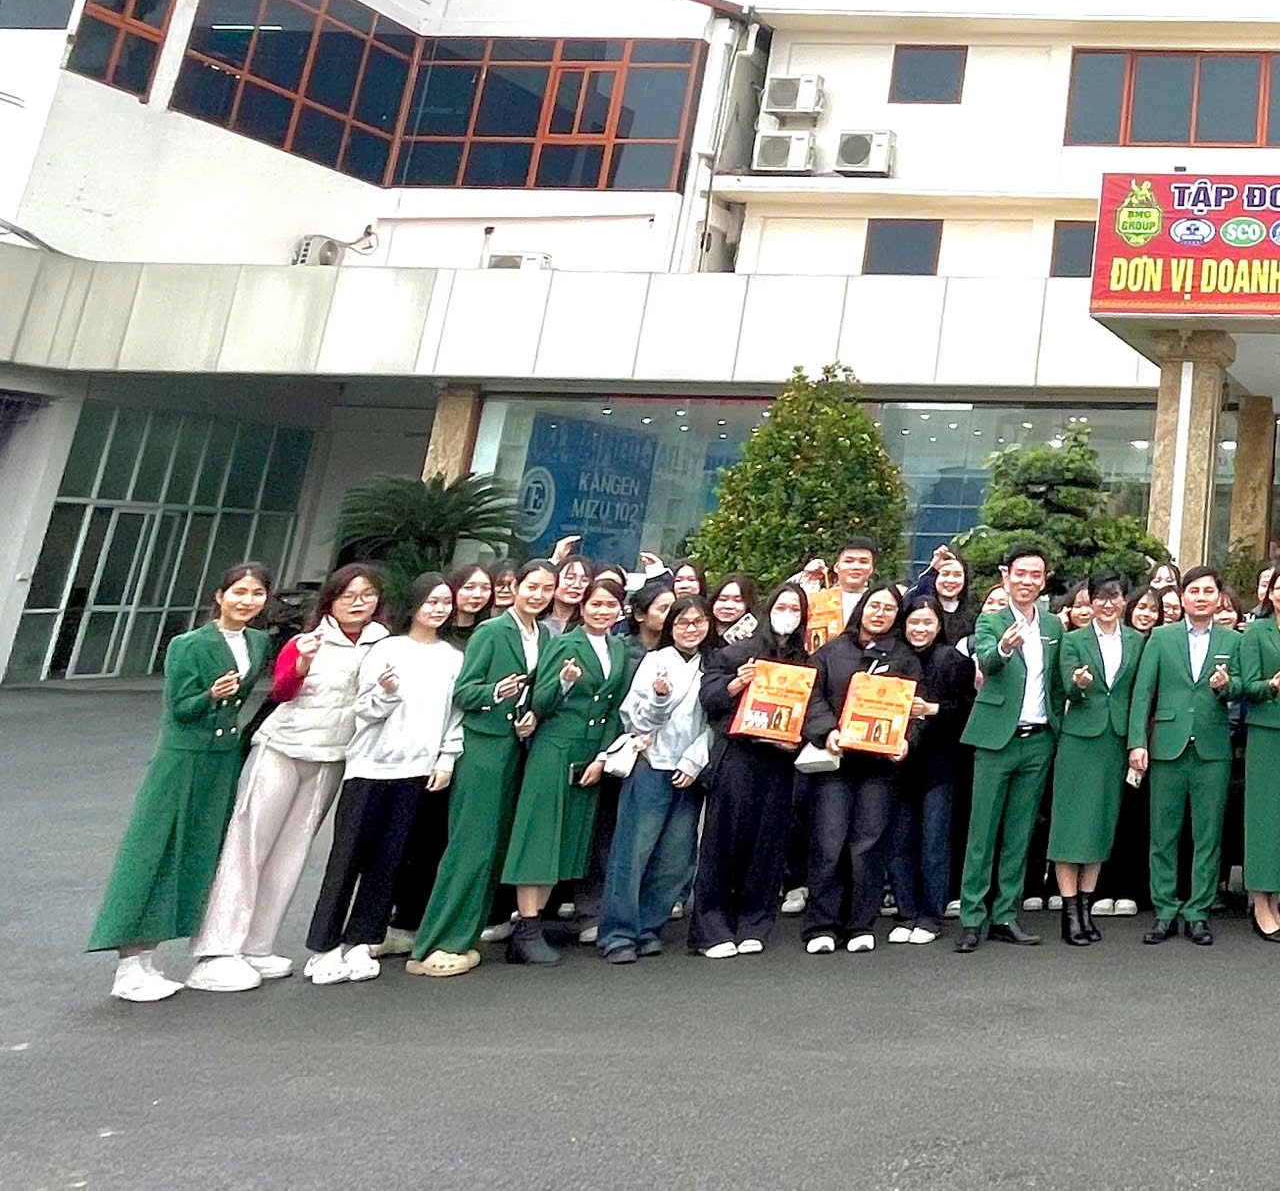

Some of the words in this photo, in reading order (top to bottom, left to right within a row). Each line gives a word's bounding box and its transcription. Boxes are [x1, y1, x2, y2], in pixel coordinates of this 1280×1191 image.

[1171, 179, 1236, 214] TẬP
[1121, 220, 1156, 231] GROUP
[1226, 223, 1261, 241] SCO
[1109, 255, 1164, 292] ĐƠN
[1170, 258, 1195, 300] VỊ
[578, 471, 640, 497] KANGEN
